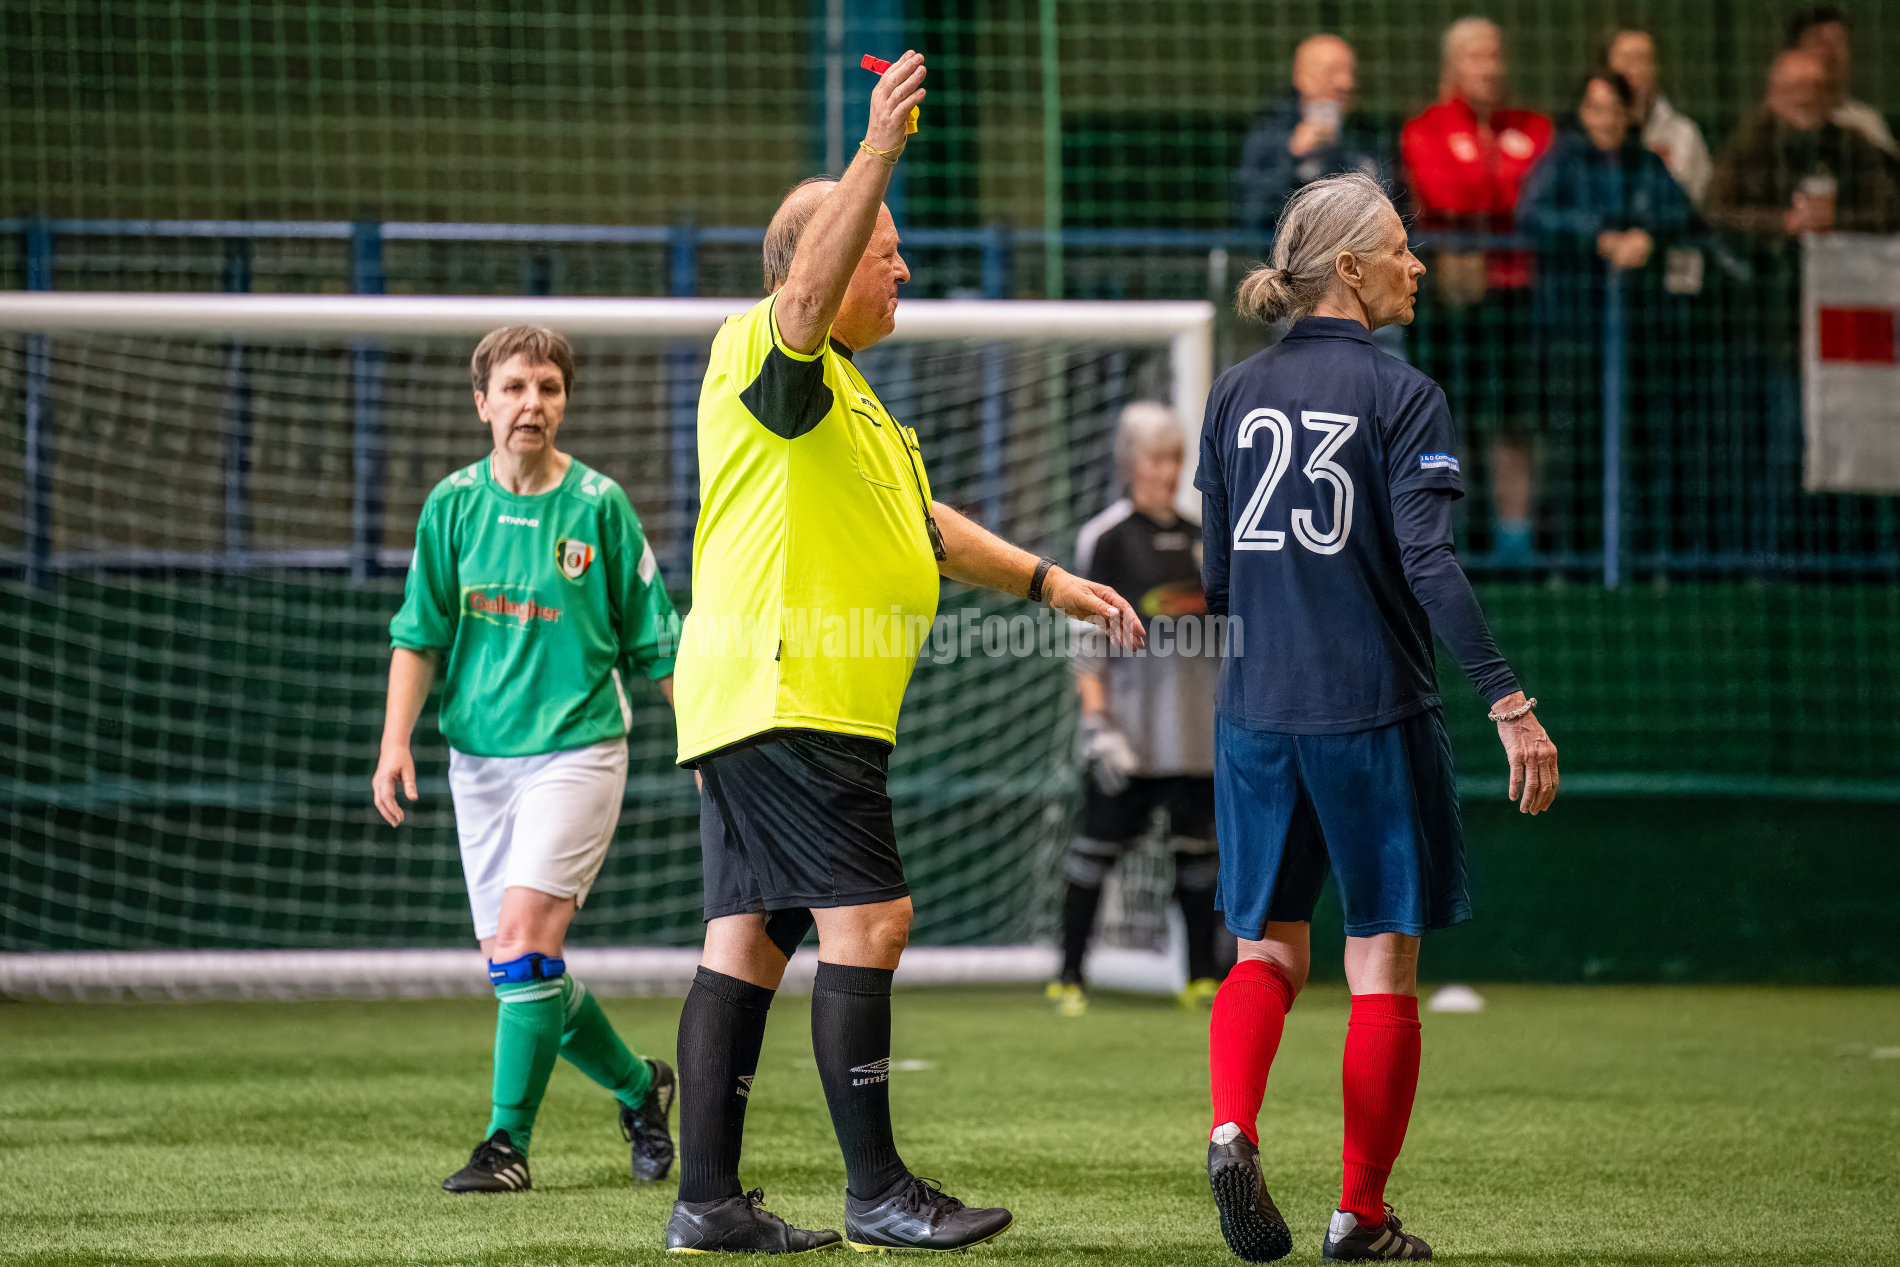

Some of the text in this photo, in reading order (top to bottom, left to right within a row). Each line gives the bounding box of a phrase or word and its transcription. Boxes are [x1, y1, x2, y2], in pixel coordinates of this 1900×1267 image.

[1234, 408, 1359, 555] 23
[470, 592, 562, 622] Gallagher
[852, 1073, 888, 1086] umb
